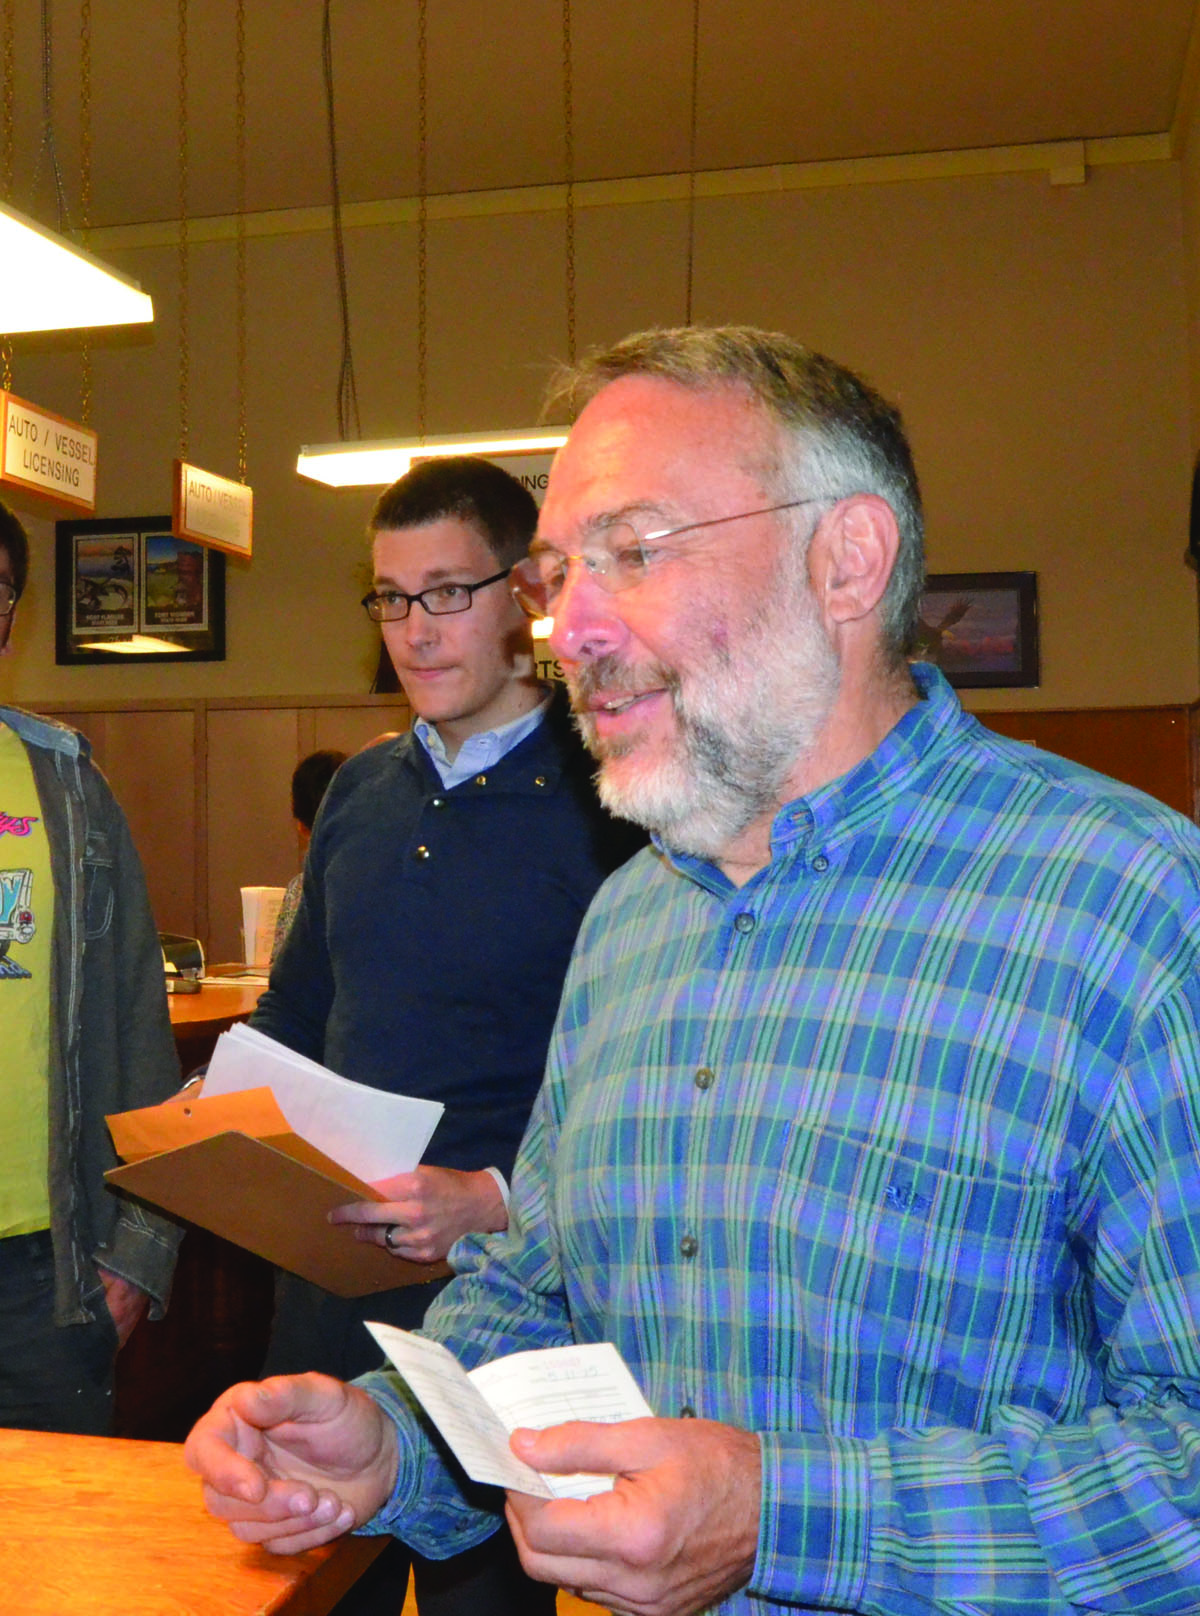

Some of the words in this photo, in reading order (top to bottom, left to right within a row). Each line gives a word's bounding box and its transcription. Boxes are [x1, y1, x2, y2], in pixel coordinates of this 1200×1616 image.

[8, 415, 39, 443] AUTO
[55, 432, 96, 466] VESSEL
[23, 448, 80, 487] LICENSING
[520, 473, 550, 490] ING
[535, 660, 566, 678] TS
